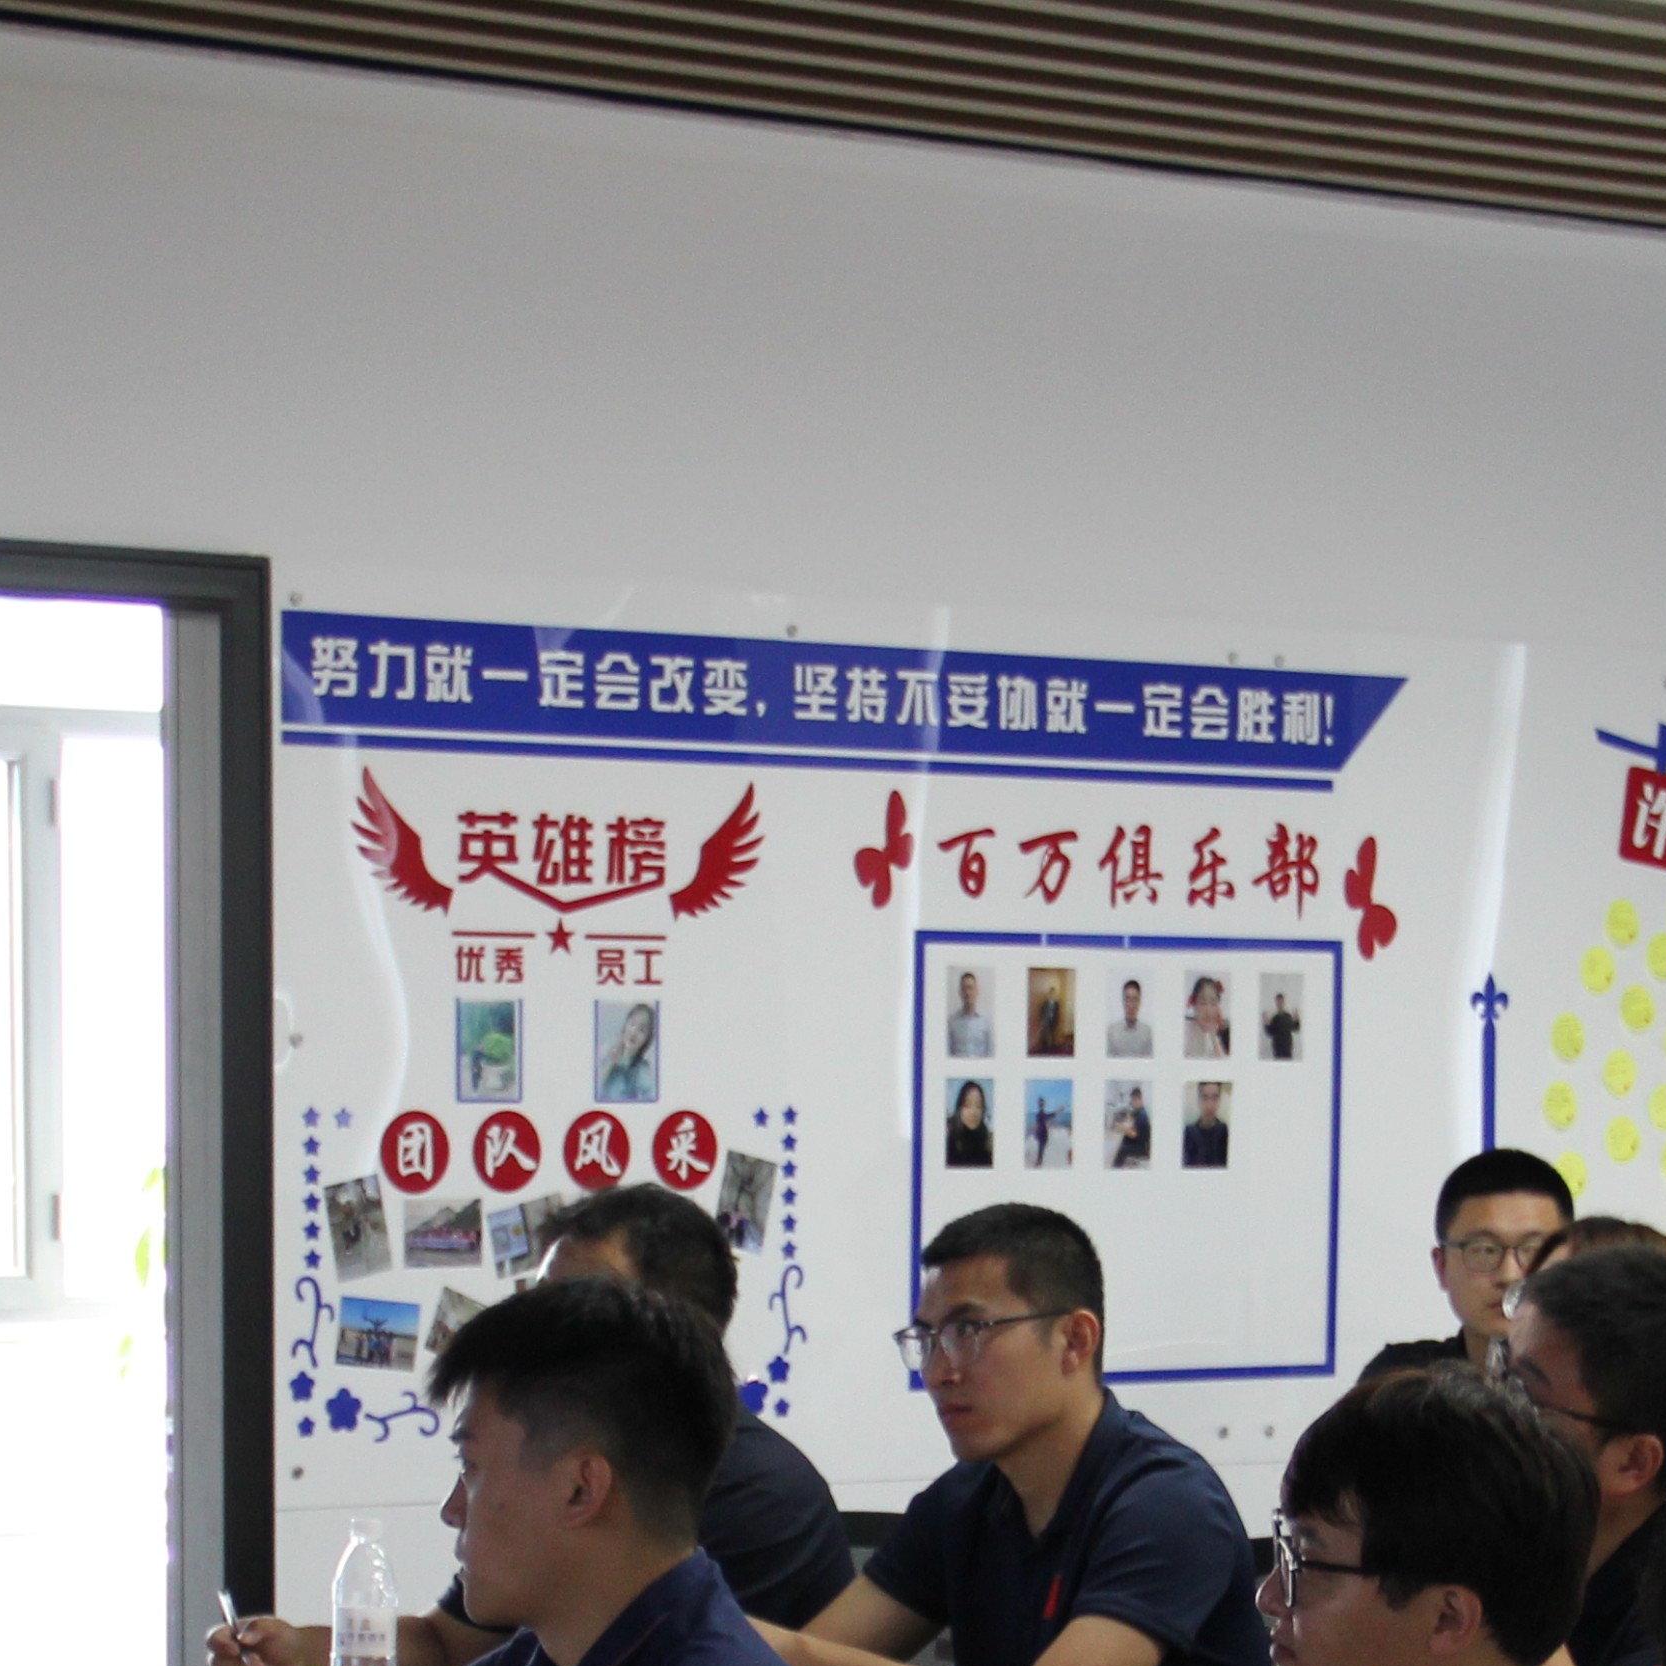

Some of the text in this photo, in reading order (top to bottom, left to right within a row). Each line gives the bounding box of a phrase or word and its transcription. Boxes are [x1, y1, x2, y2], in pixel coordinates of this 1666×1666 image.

[458, 811, 667, 887] 英雄榜
[938, 822, 1320, 920] 百万俱乐部
[455, 946, 663, 986] 优秀 员工
[395, 1116, 711, 1182] 团队风采
